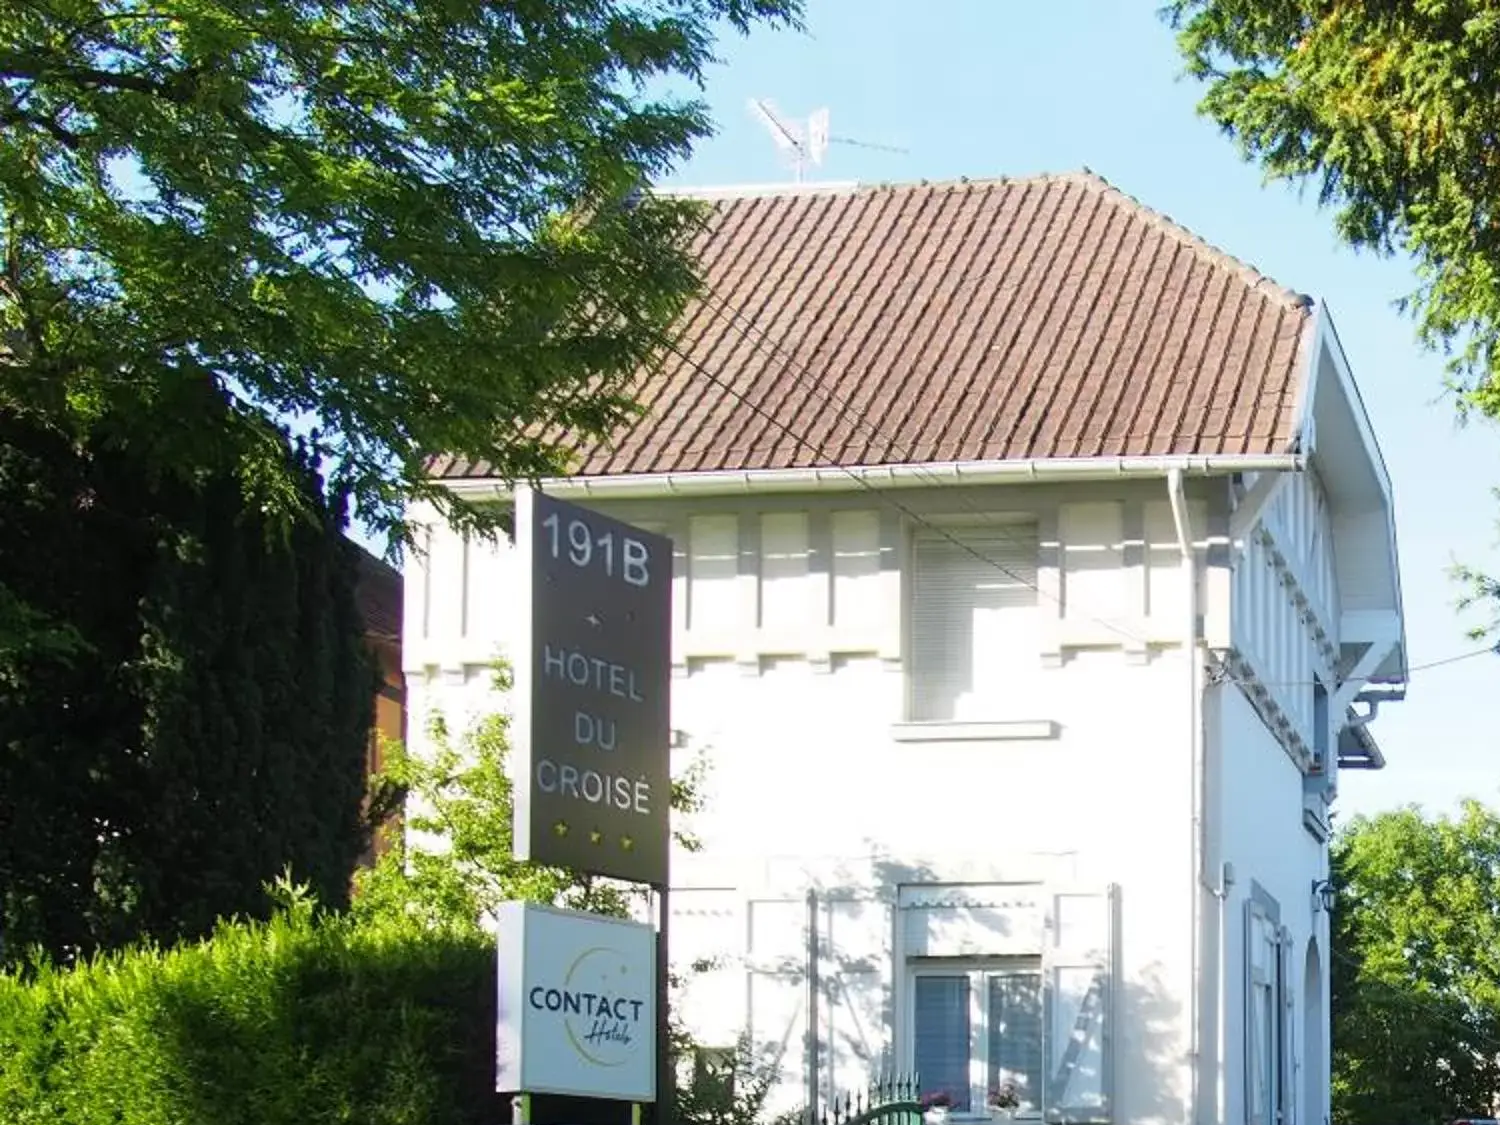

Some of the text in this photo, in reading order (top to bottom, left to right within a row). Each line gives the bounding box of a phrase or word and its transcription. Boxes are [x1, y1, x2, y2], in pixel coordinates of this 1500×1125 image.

[542, 512, 651, 587] 191B
[575, 711, 616, 750] DU
[536, 759, 650, 814] CROISÉ
[529, 986, 643, 1021] CONTACT
